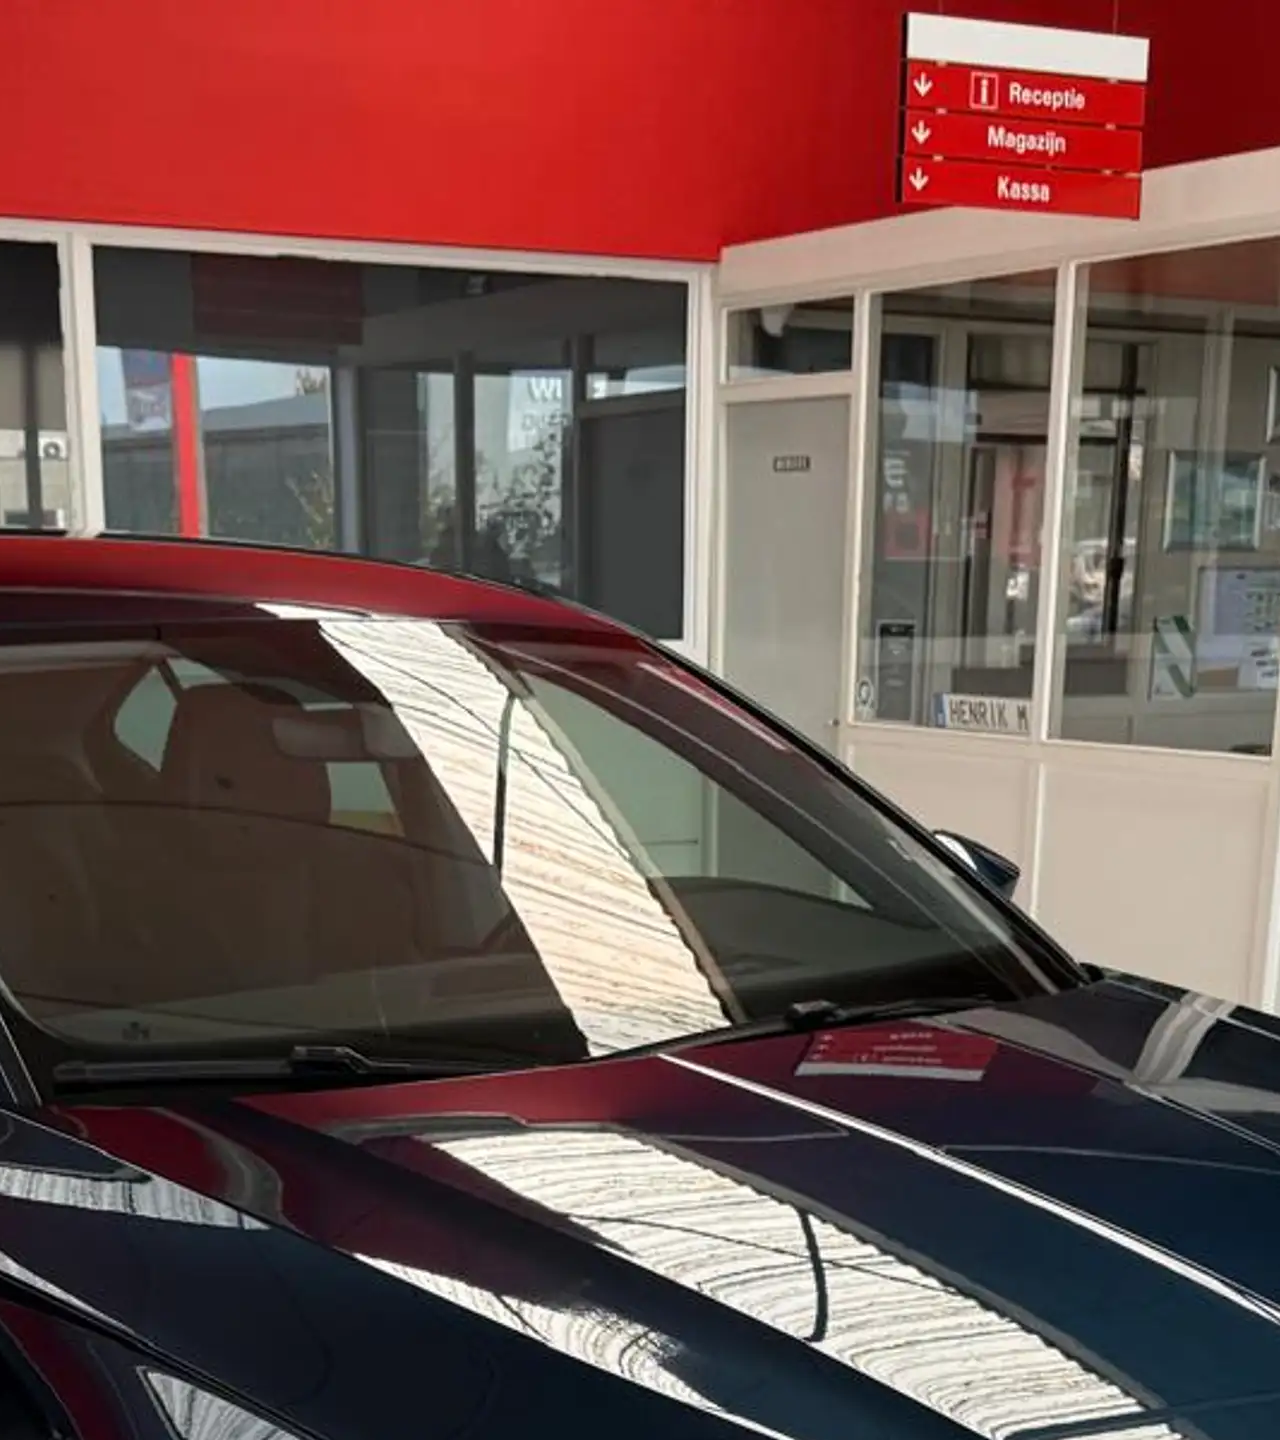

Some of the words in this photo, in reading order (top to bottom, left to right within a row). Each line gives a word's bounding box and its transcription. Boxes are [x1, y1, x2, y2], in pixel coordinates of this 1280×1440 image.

[1009, 81, 1085, 112] Receptie
[987, 124, 1066, 157] Magazijn
[997, 175, 1050, 203] Kassa
[948, 698, 1009, 729] HENRIK
